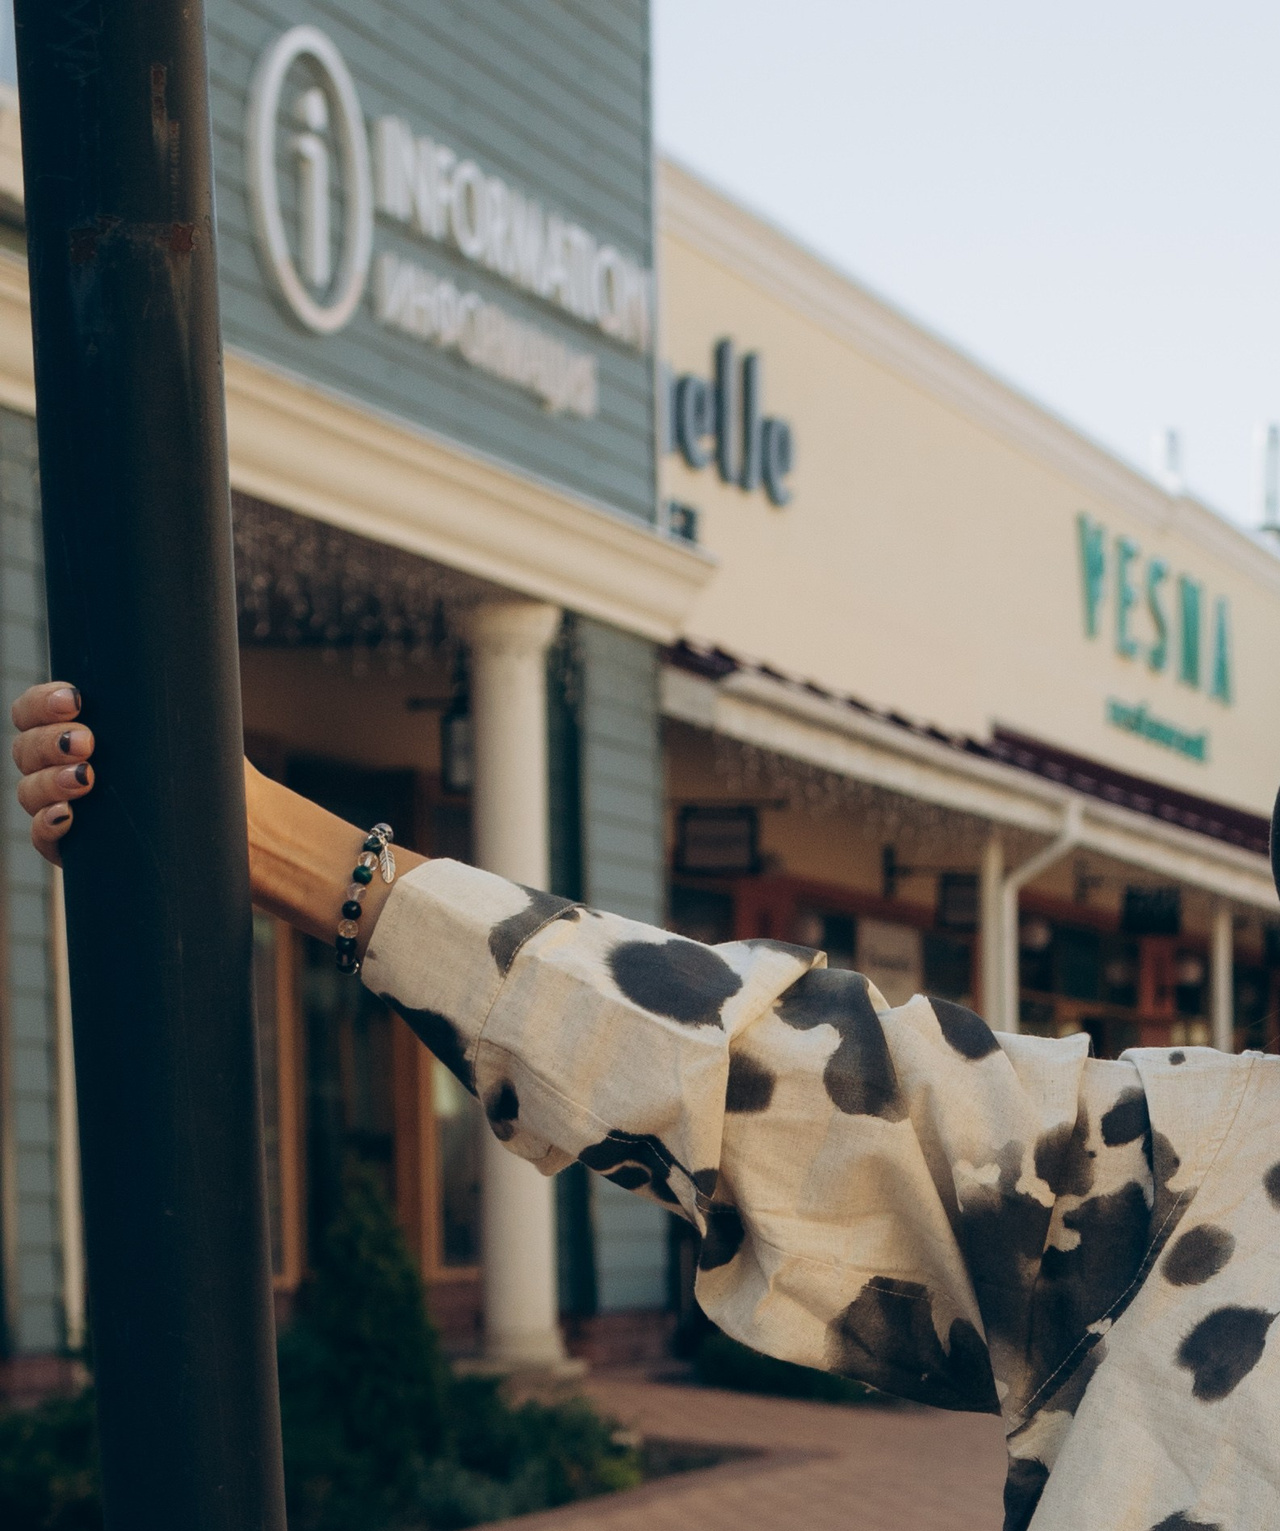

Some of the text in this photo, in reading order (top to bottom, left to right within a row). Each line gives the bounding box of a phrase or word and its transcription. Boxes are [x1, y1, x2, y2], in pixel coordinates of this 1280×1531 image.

[374, 115, 651, 355] INFORMATION
[663, 336, 794, 508] elle
[1075, 512, 1234, 707] VESNA
